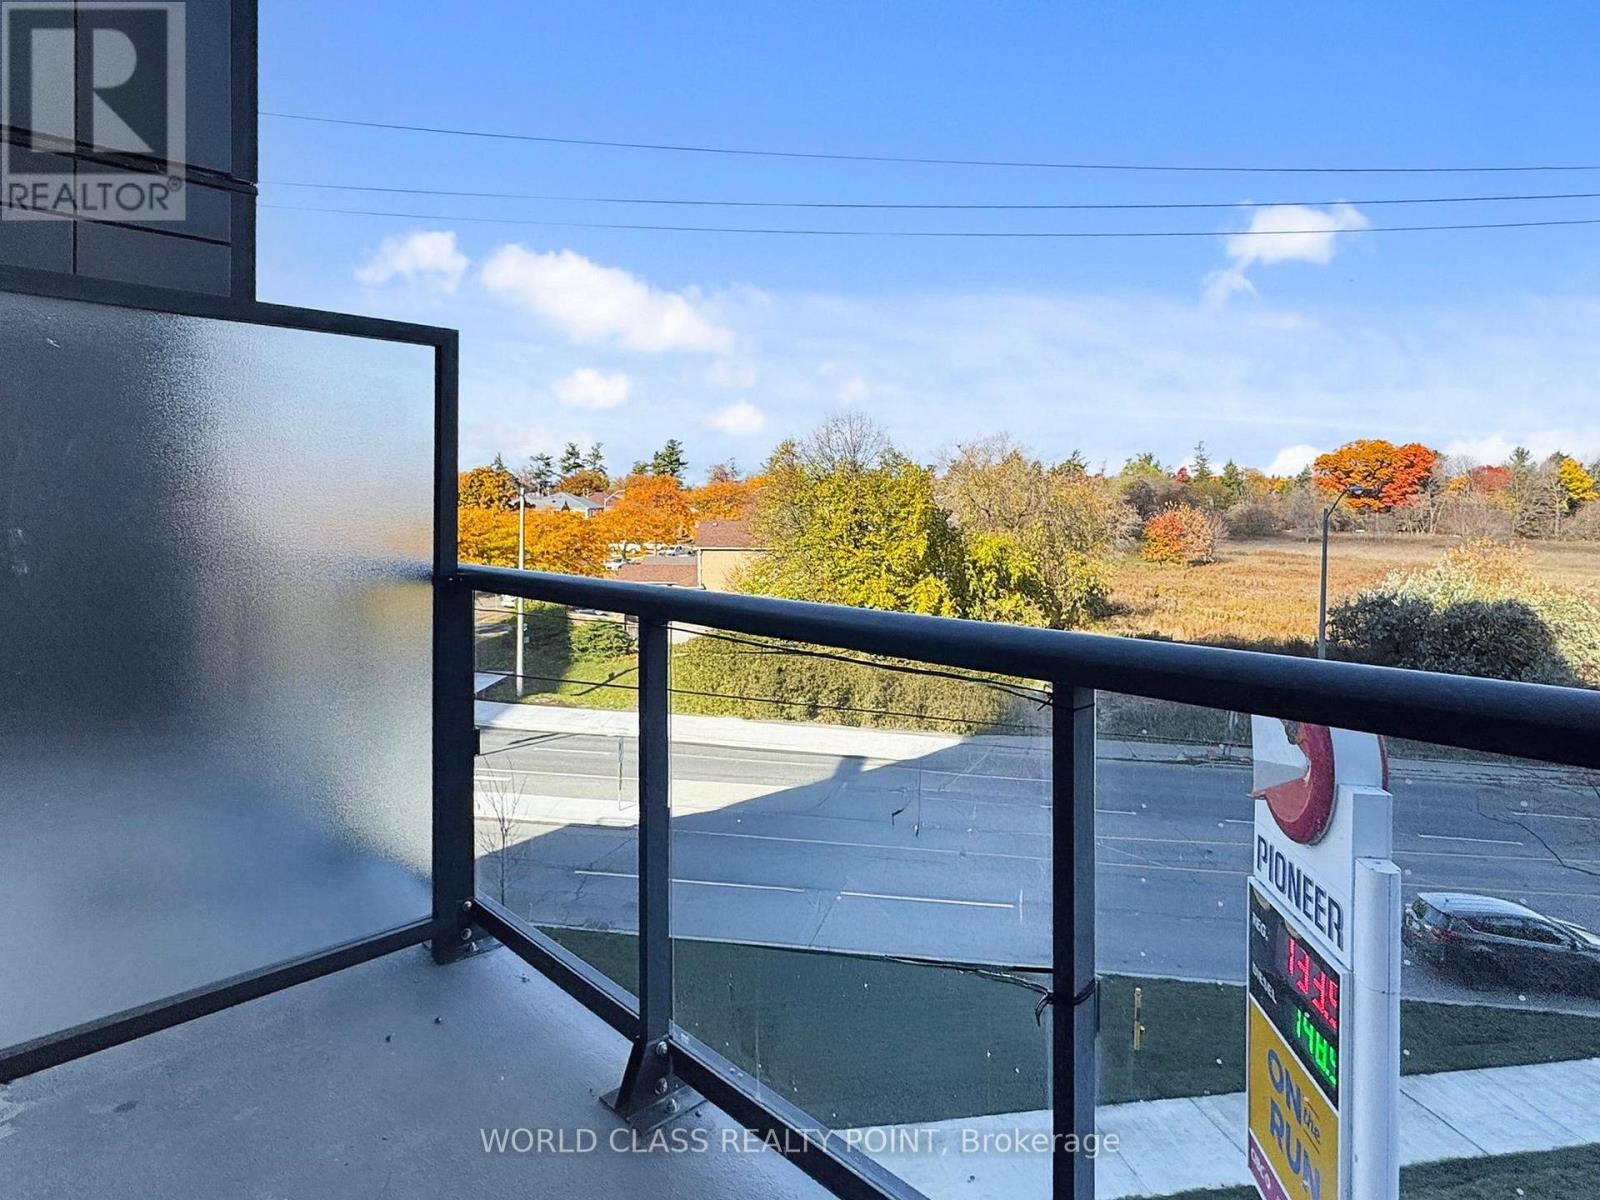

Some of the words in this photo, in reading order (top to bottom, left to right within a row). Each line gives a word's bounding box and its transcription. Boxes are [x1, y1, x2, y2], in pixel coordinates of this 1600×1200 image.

[1257, 834, 1344, 952] PIONEER
[1267, 1049, 1302, 1126] ON
[1303, 1106, 1321, 1145] the
[1270, 1096, 1321, 1200] RUN
